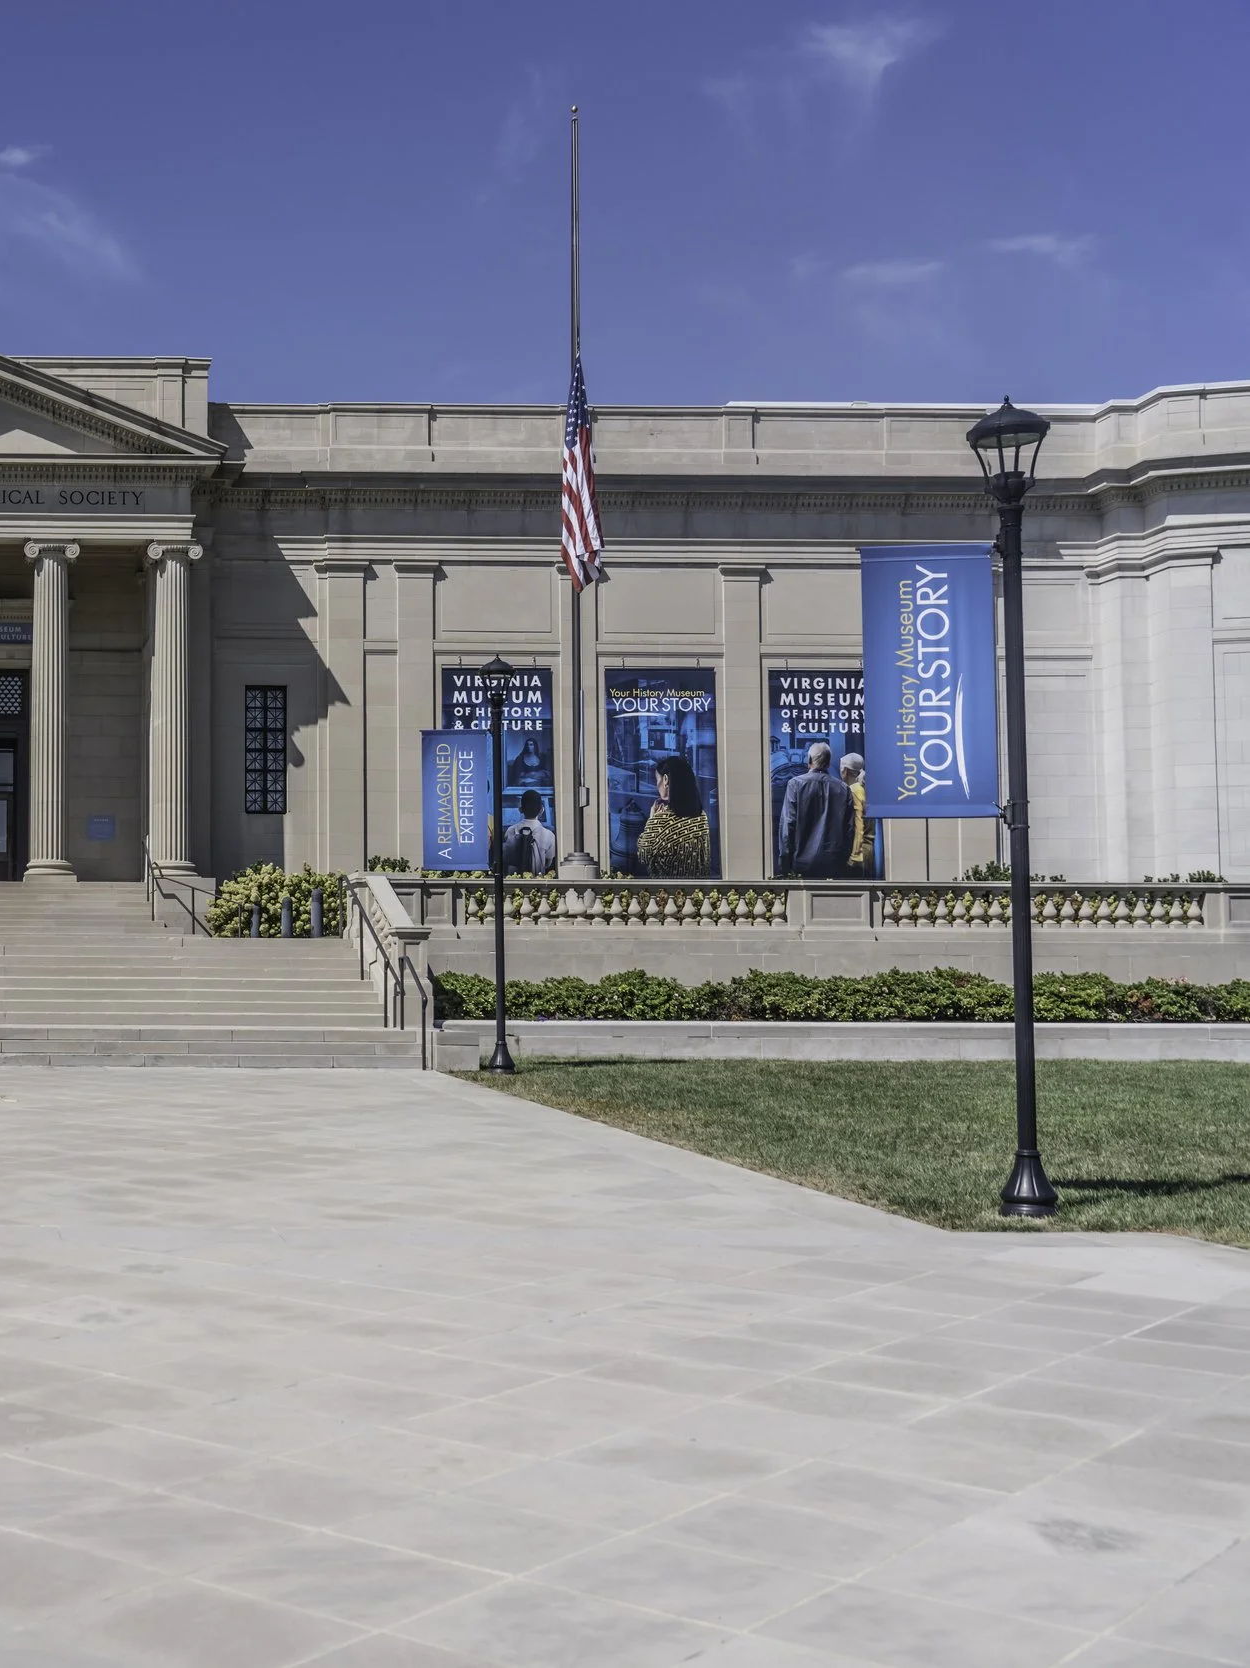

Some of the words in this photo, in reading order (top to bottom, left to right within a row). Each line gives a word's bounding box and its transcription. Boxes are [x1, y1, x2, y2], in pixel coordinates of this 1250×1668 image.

[58, 490, 144, 506] SOCIETY
[894, 580, 914, 668] Museum
[916, 564, 951, 678] STORY
[453, 676, 542, 686] VIRGINIA
[780, 678, 864, 689] VIRGINIA
[610, 688, 630, 697] Your
[632, 688, 664, 699] History
[666, 689, 705, 697] Museum
[780, 693, 864, 706] MUSEUM
[612, 698, 659, 712] YOUR
[662, 698, 711, 712] STORY
[896, 675, 920, 746] History
[454, 707, 471, 716] OF
[476, 707, 542, 717] HITORY
[781, 709, 798, 718] OF
[454, 720, 464, 730] &
[471, 720, 542, 730] CUTURE
[781, 722, 792, 733] &
[798, 722, 865, 733] CULTUR
[919, 686, 952, 795] YOUR
[898, 754, 918, 800] Your
[436, 744, 452, 844] REIMAGINED
[459, 751, 474, 843] EXPERIENCE
[438, 848, 452, 860] A
